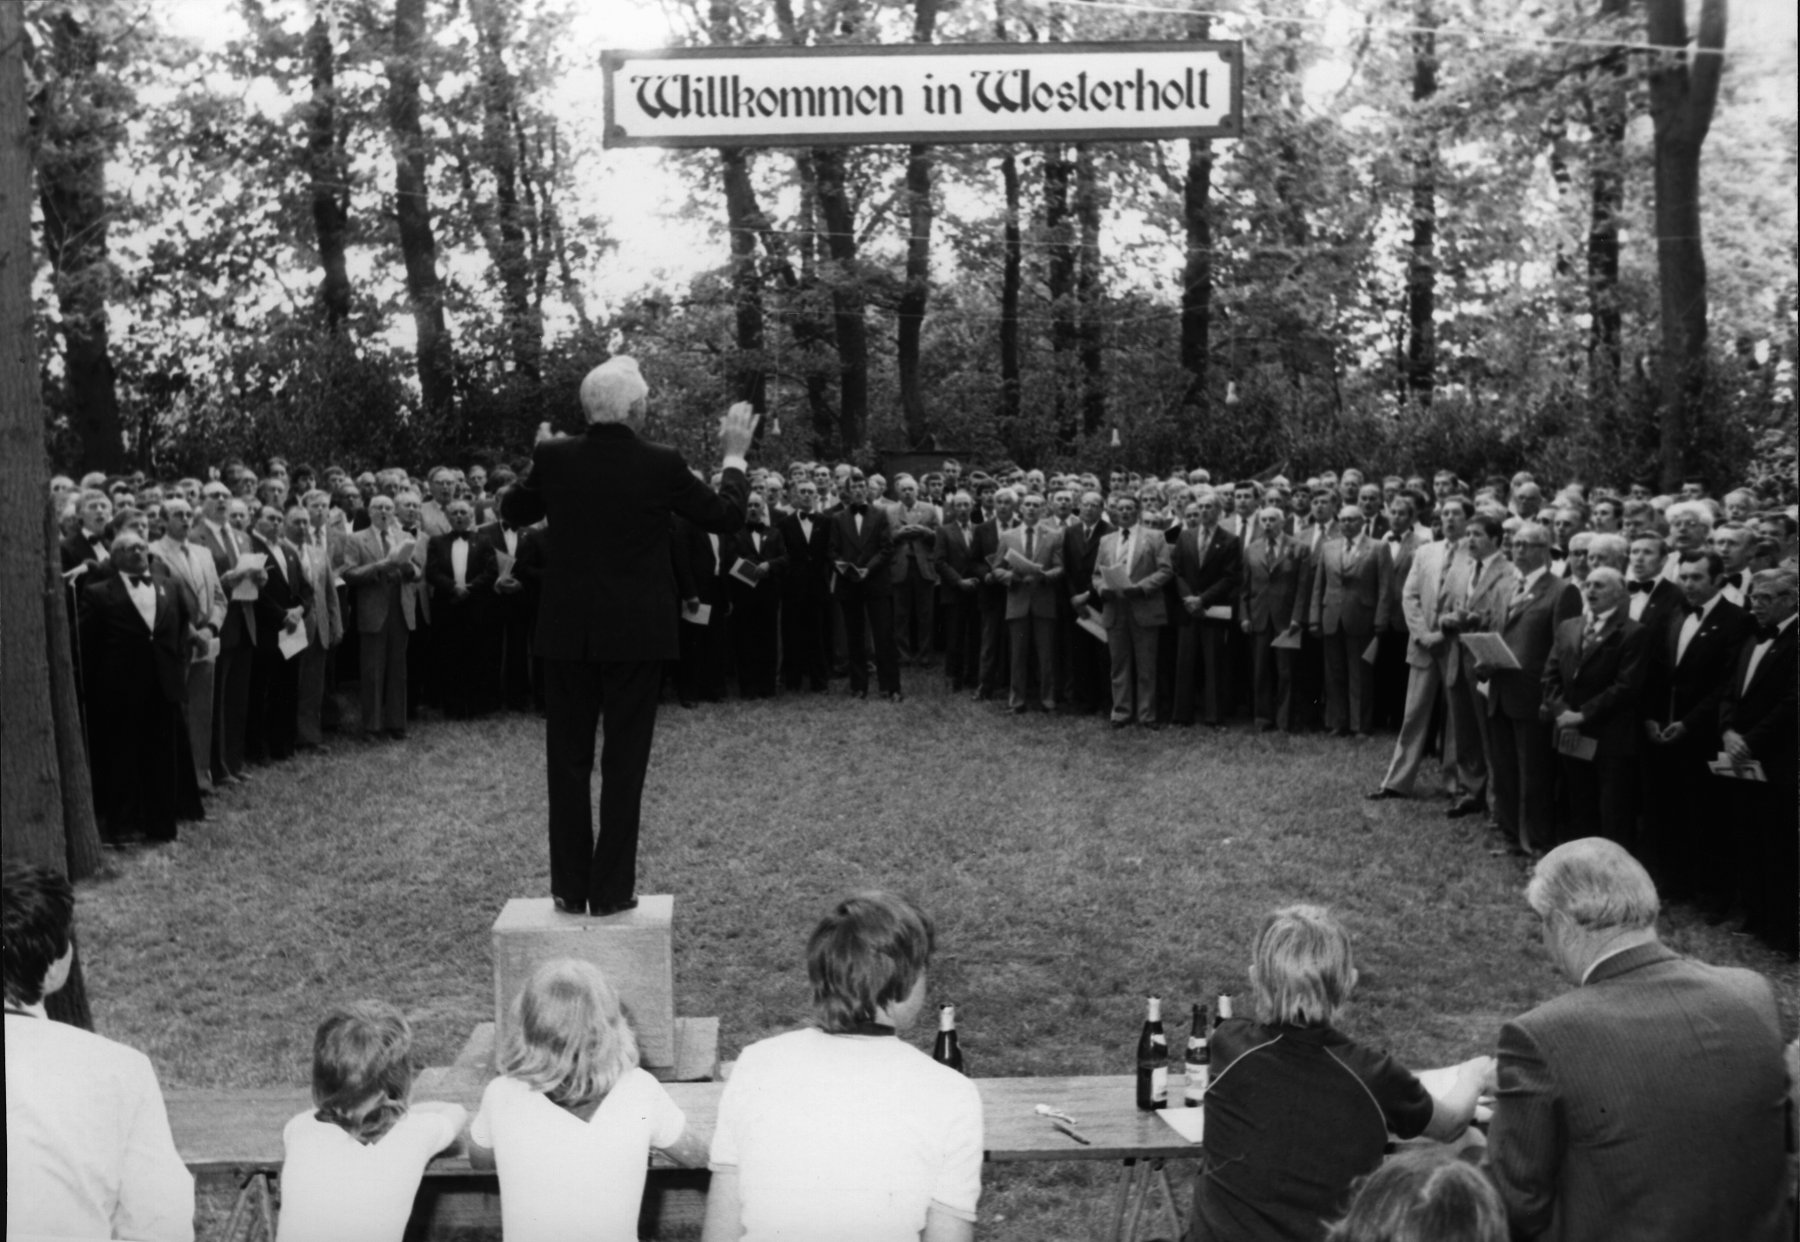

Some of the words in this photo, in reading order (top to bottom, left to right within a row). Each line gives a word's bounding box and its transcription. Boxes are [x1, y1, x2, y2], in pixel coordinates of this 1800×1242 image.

[631, 74, 903, 118] Willkommen
[923, 73, 963, 114] in
[971, 67, 1210, 113] Westerholt
